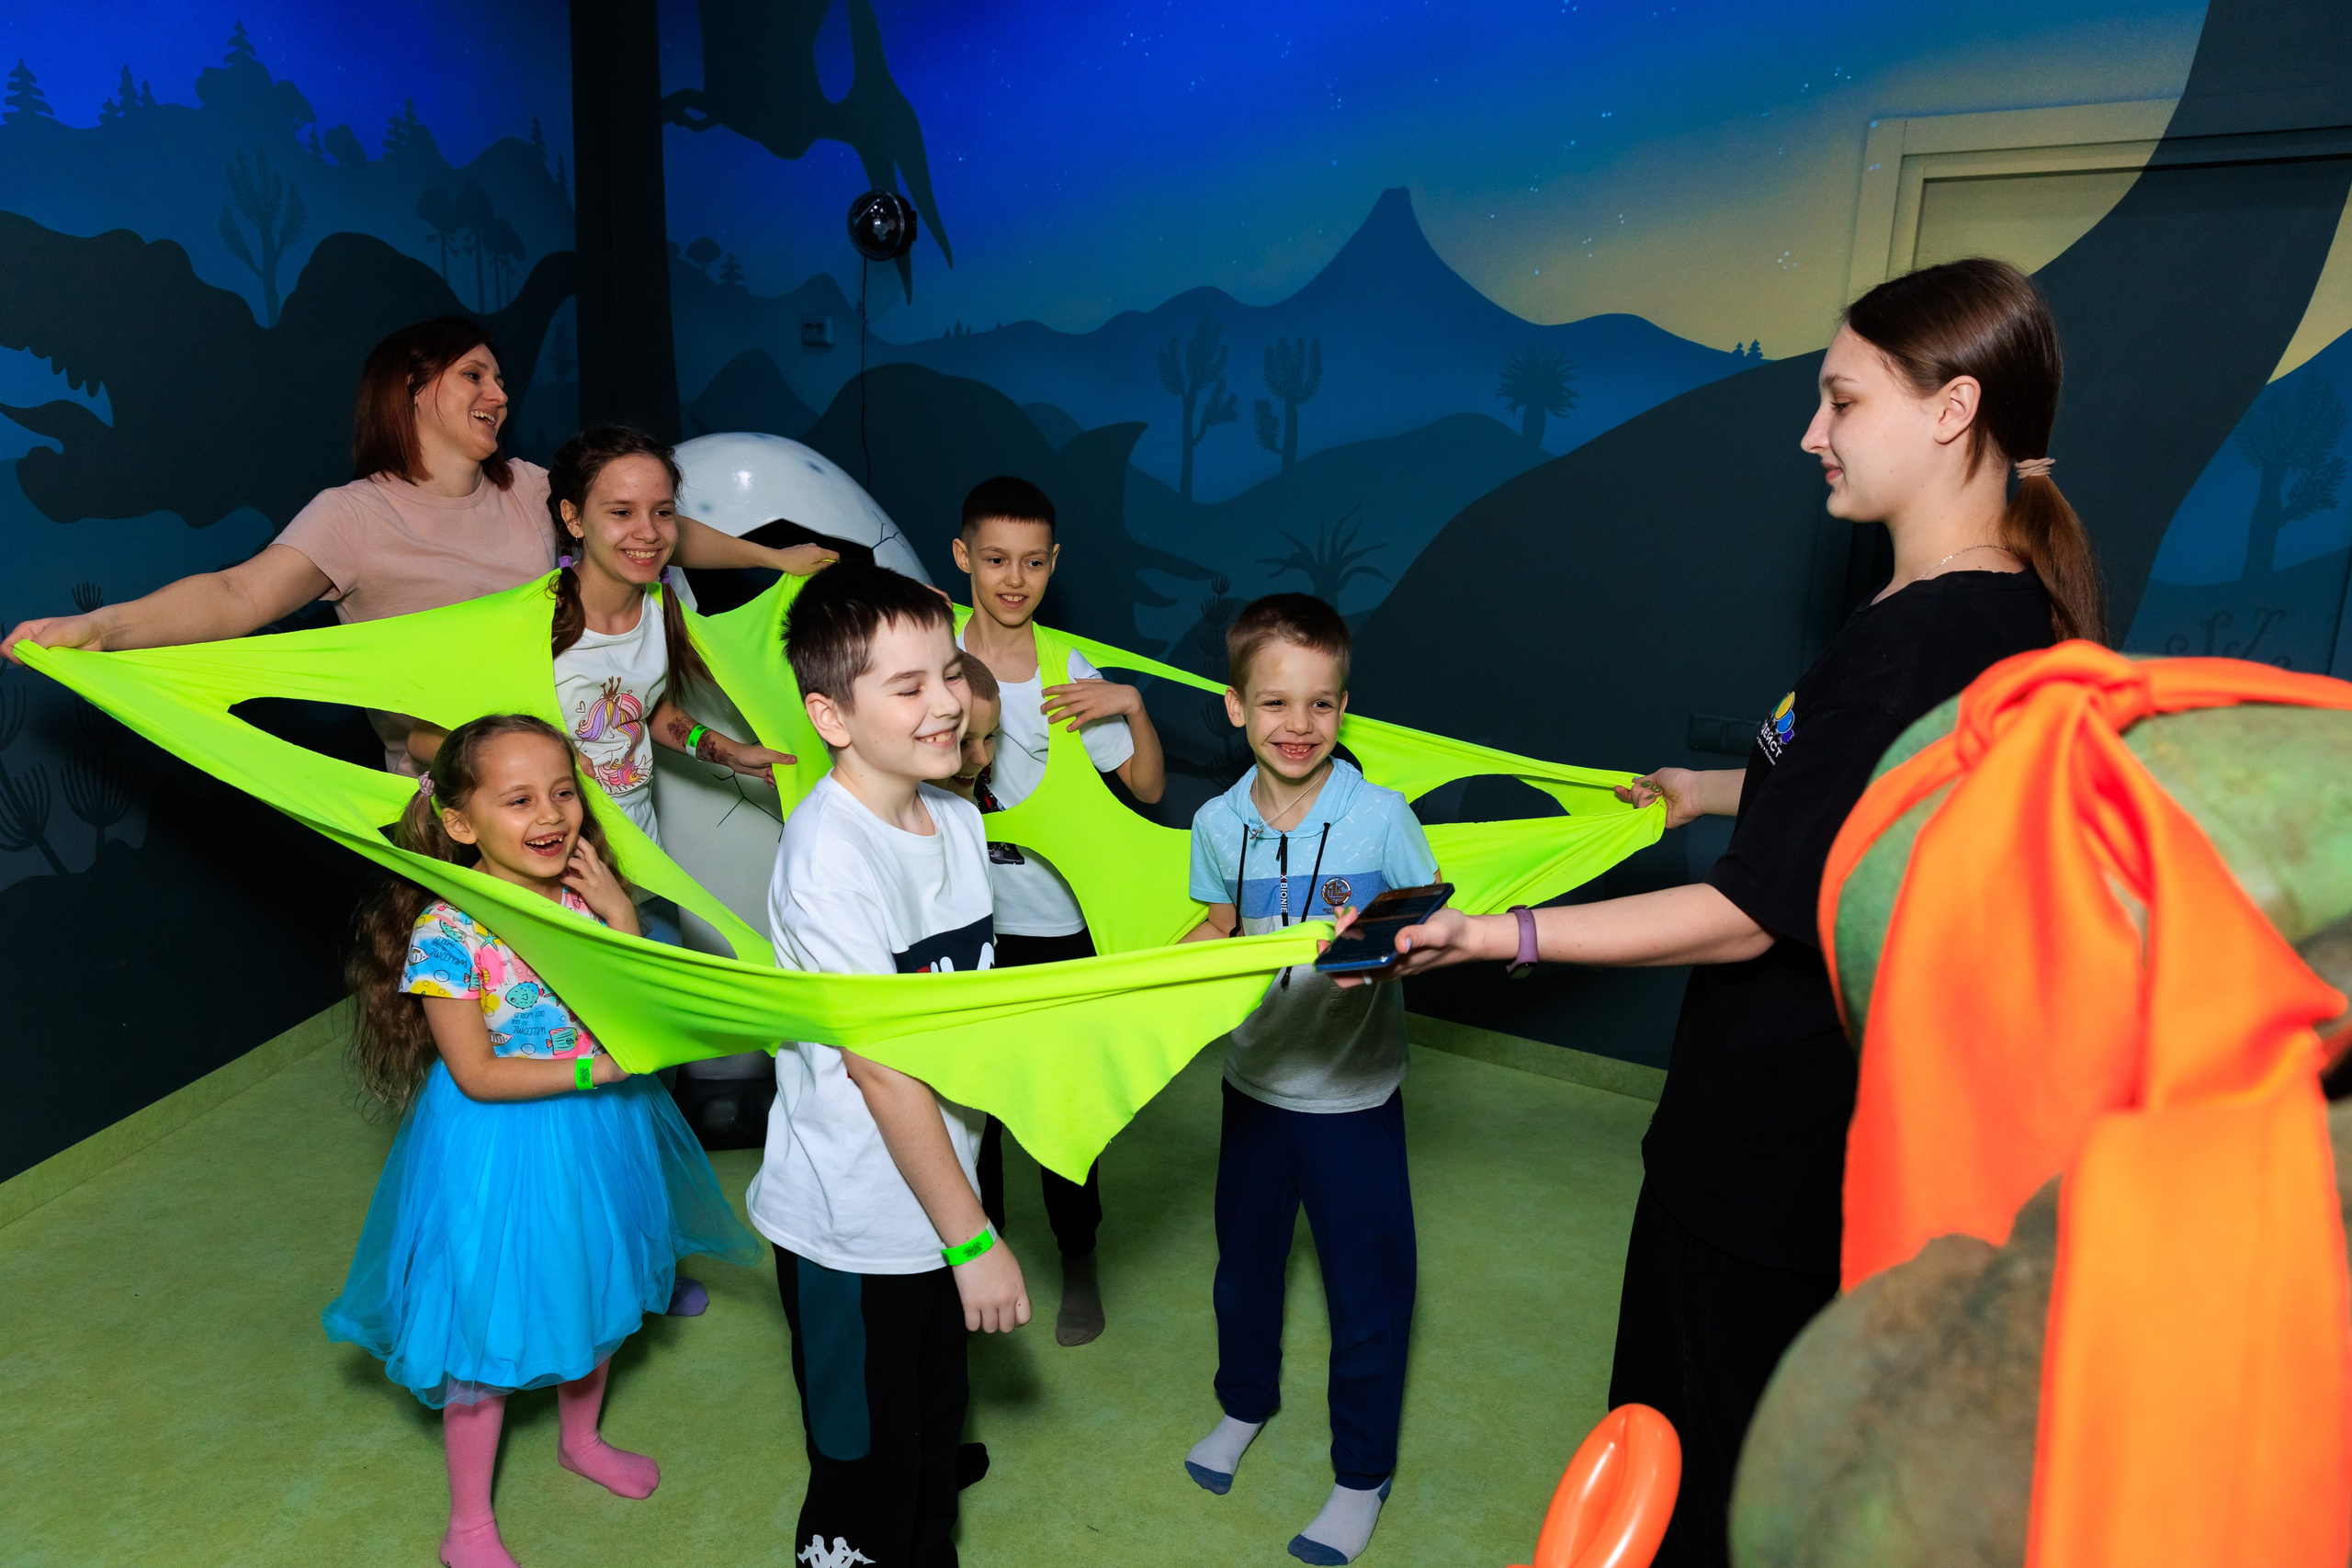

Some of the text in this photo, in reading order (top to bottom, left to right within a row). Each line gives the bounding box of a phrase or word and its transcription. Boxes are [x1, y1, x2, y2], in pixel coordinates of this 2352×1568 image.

[1761, 721, 1782, 758] ДЕЙСТ
[430, 947, 468, 969] WELCOME
[513, 1024, 547, 1036] WELCOME
